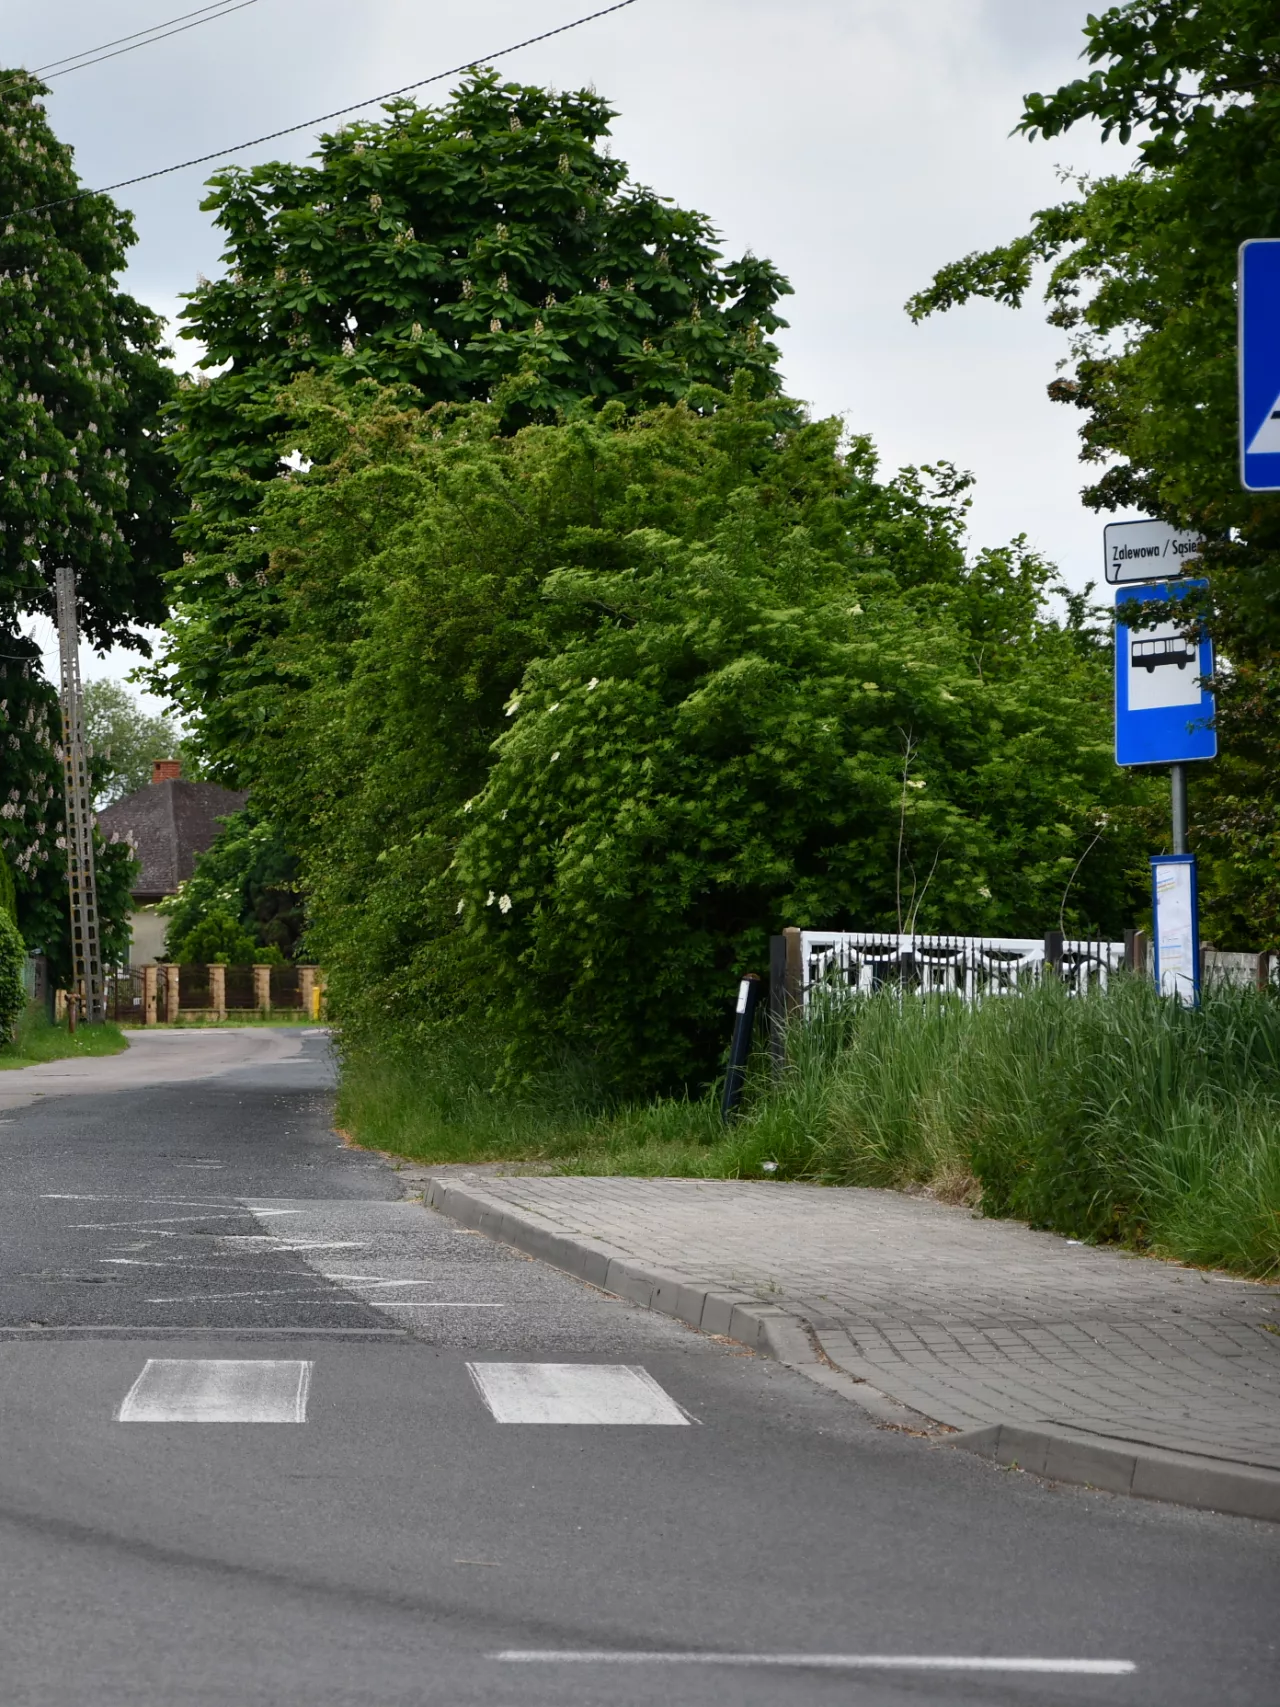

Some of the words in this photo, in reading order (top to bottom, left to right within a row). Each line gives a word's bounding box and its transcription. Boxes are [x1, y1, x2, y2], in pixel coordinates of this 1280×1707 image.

[1112, 544, 1160, 561] Zalewowa
[1162, 539, 1170, 558] /
[1172, 537, 1200, 557] Sąsie
[1112, 563, 1122, 581] 7
